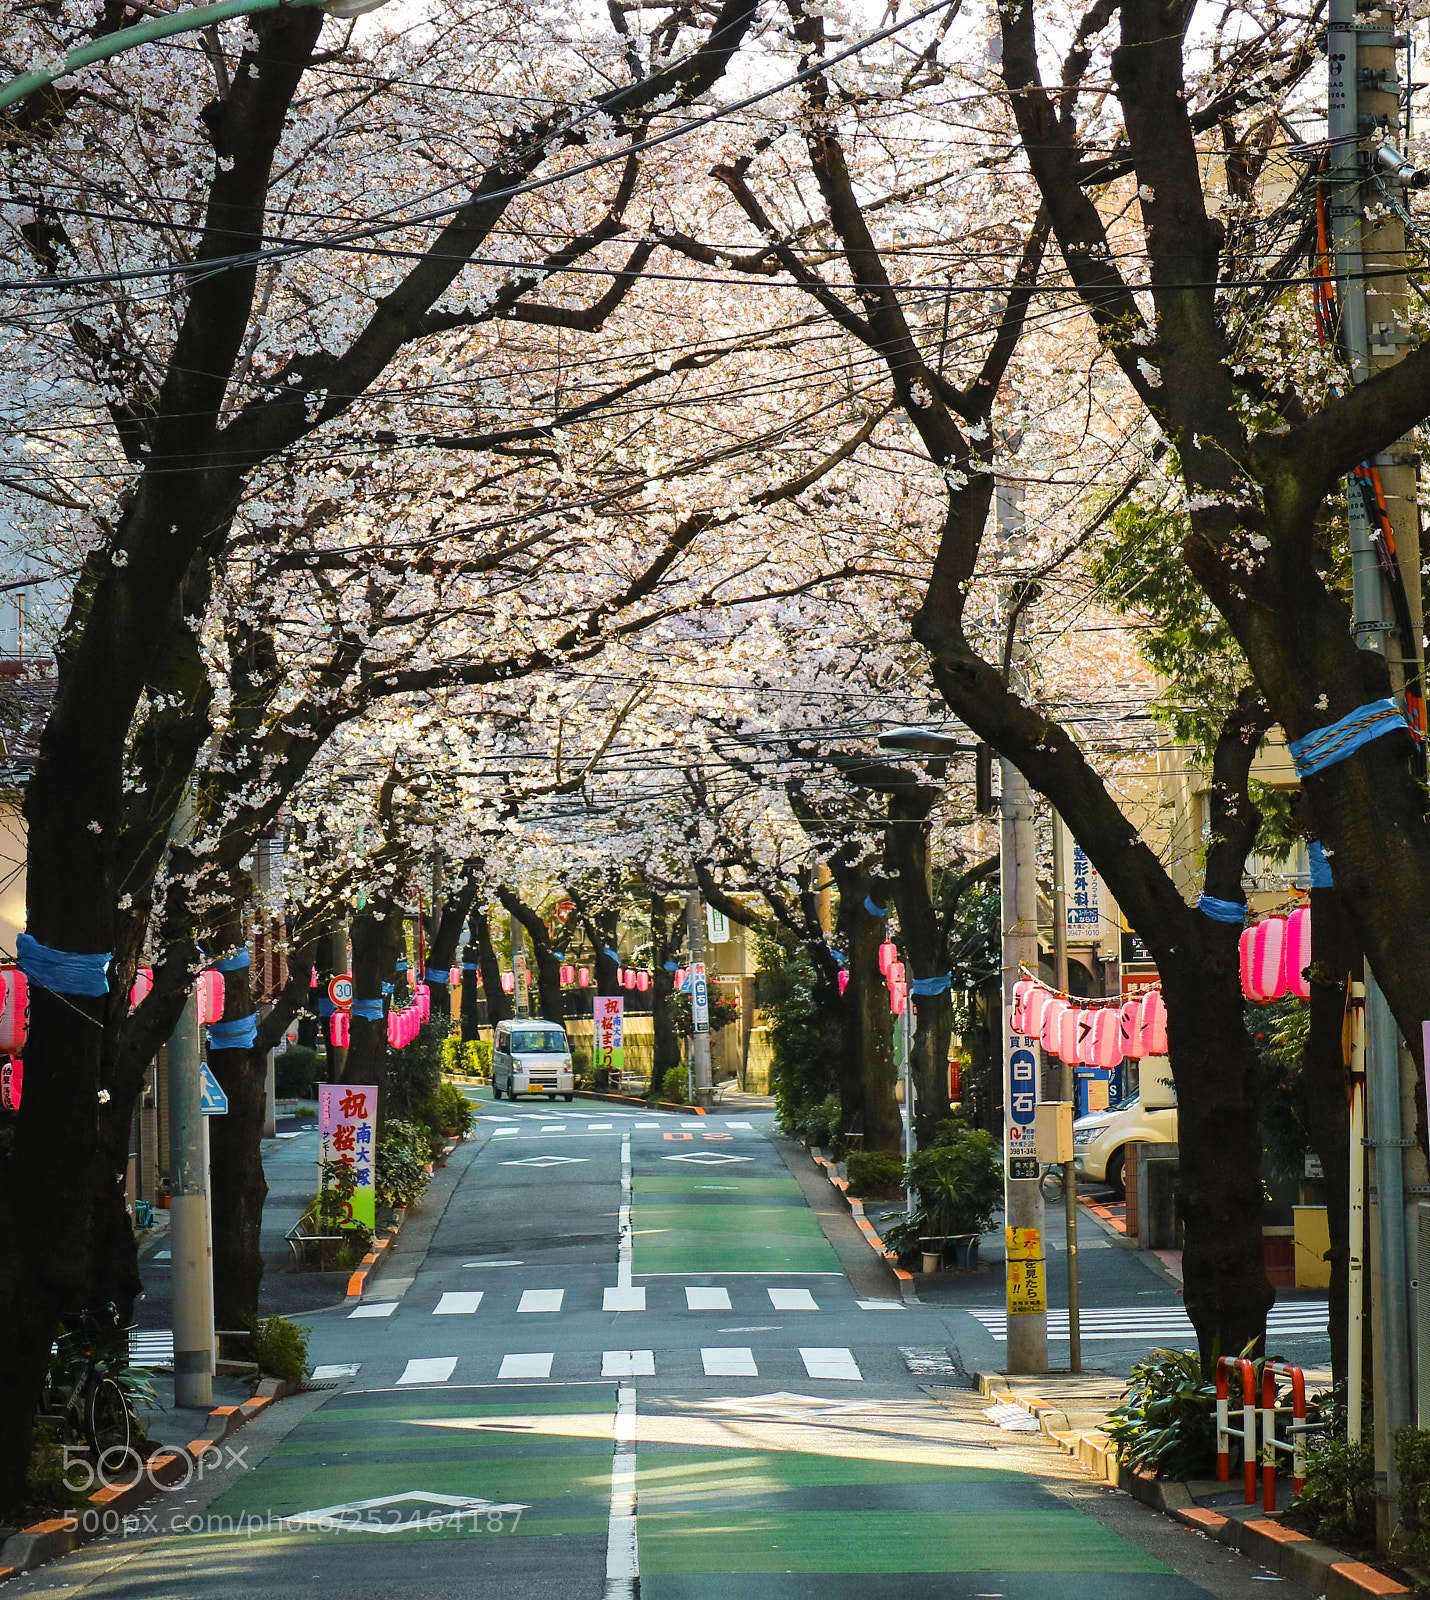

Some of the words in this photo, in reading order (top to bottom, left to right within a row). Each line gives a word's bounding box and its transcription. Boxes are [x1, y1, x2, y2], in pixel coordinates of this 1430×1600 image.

[336, 983, 352, 998] 30
[1010, 1036, 1035, 1048] 買取
[1012, 1060, 1034, 1112] 白石
[339, 1089, 368, 1119] 祝
[356, 1122, 372, 1187] 南大塚
